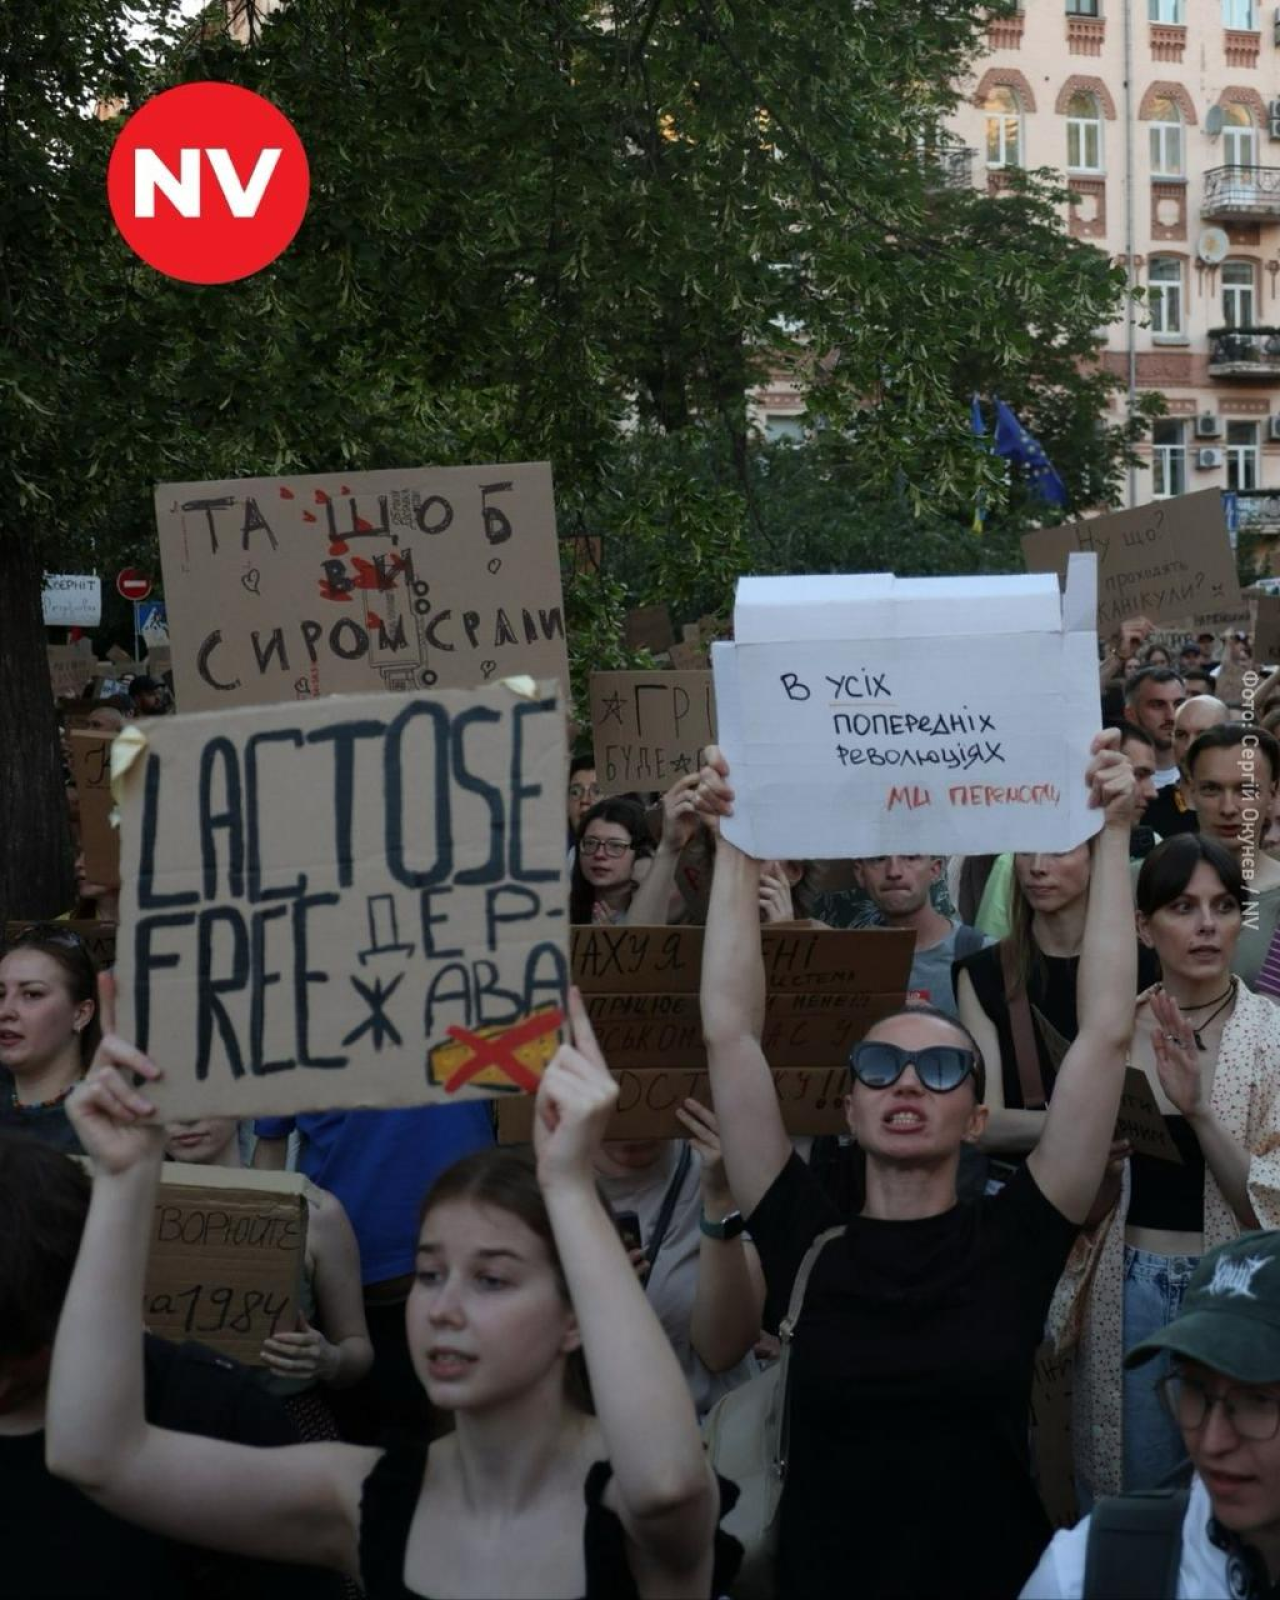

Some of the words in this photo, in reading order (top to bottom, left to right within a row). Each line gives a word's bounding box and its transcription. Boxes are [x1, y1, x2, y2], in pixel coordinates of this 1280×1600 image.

[182, 495, 280, 556] ТА
[325, 480, 515, 546] ЩОБ
[196, 612, 409, 692] СИРОМ
[425, 606, 565, 653] СРАЛИ
[780, 672, 812, 702] В
[825, 667, 892, 700] УСІХ
[137, 698, 562, 910] LACTOSE
[886, 785, 932, 813] МИ
[134, 891, 349, 1086] FREE
